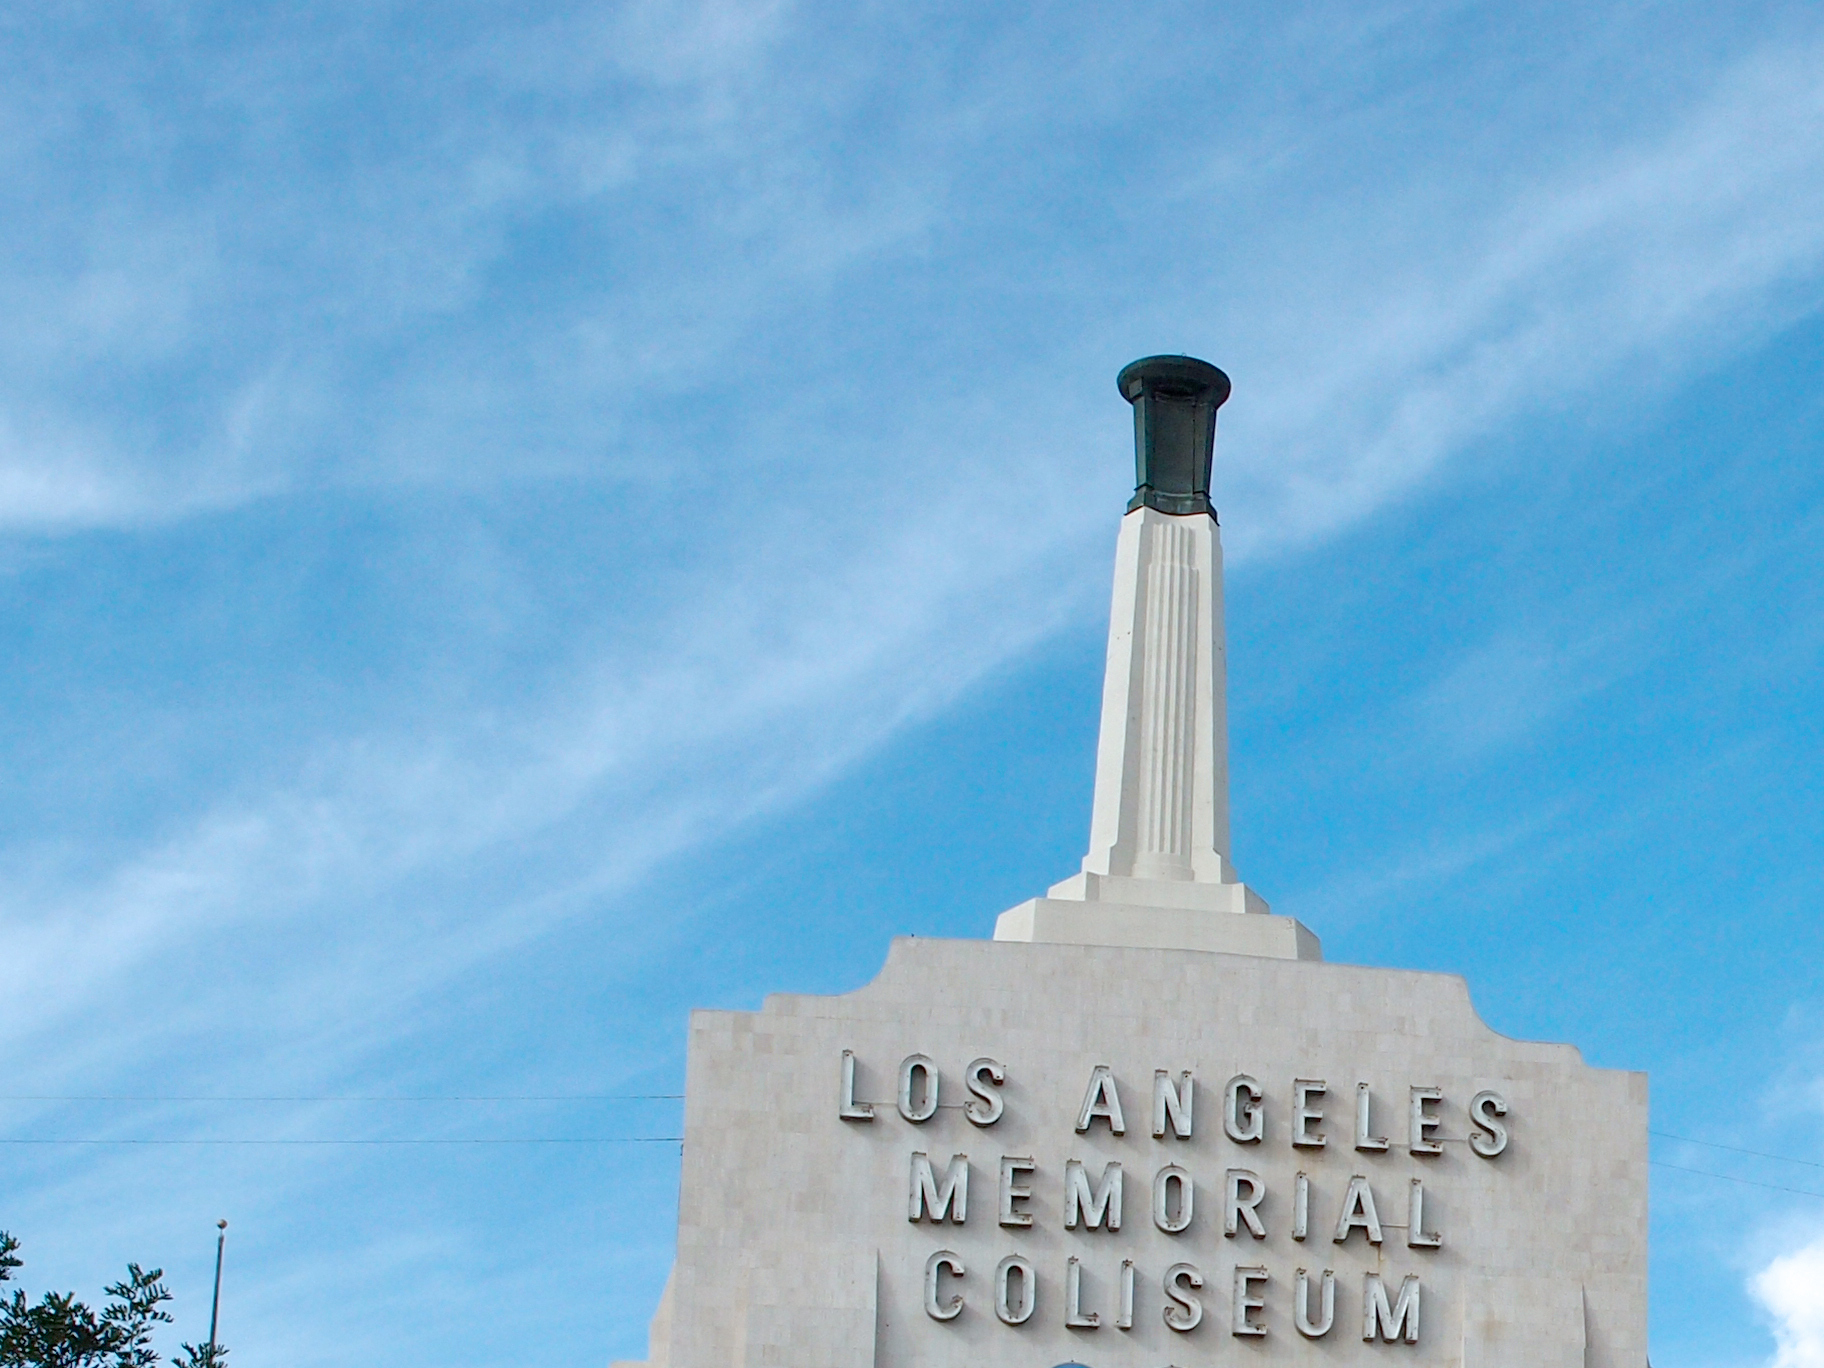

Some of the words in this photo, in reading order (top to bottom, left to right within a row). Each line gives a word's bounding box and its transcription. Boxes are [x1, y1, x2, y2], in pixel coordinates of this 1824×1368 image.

[839, 1049, 1004, 1128] LOS
[1074, 1065, 1509, 1160] ANGELES
[908, 1151, 1443, 1249] MEMORIAL
[924, 1249, 1421, 1344] COLISEUM
